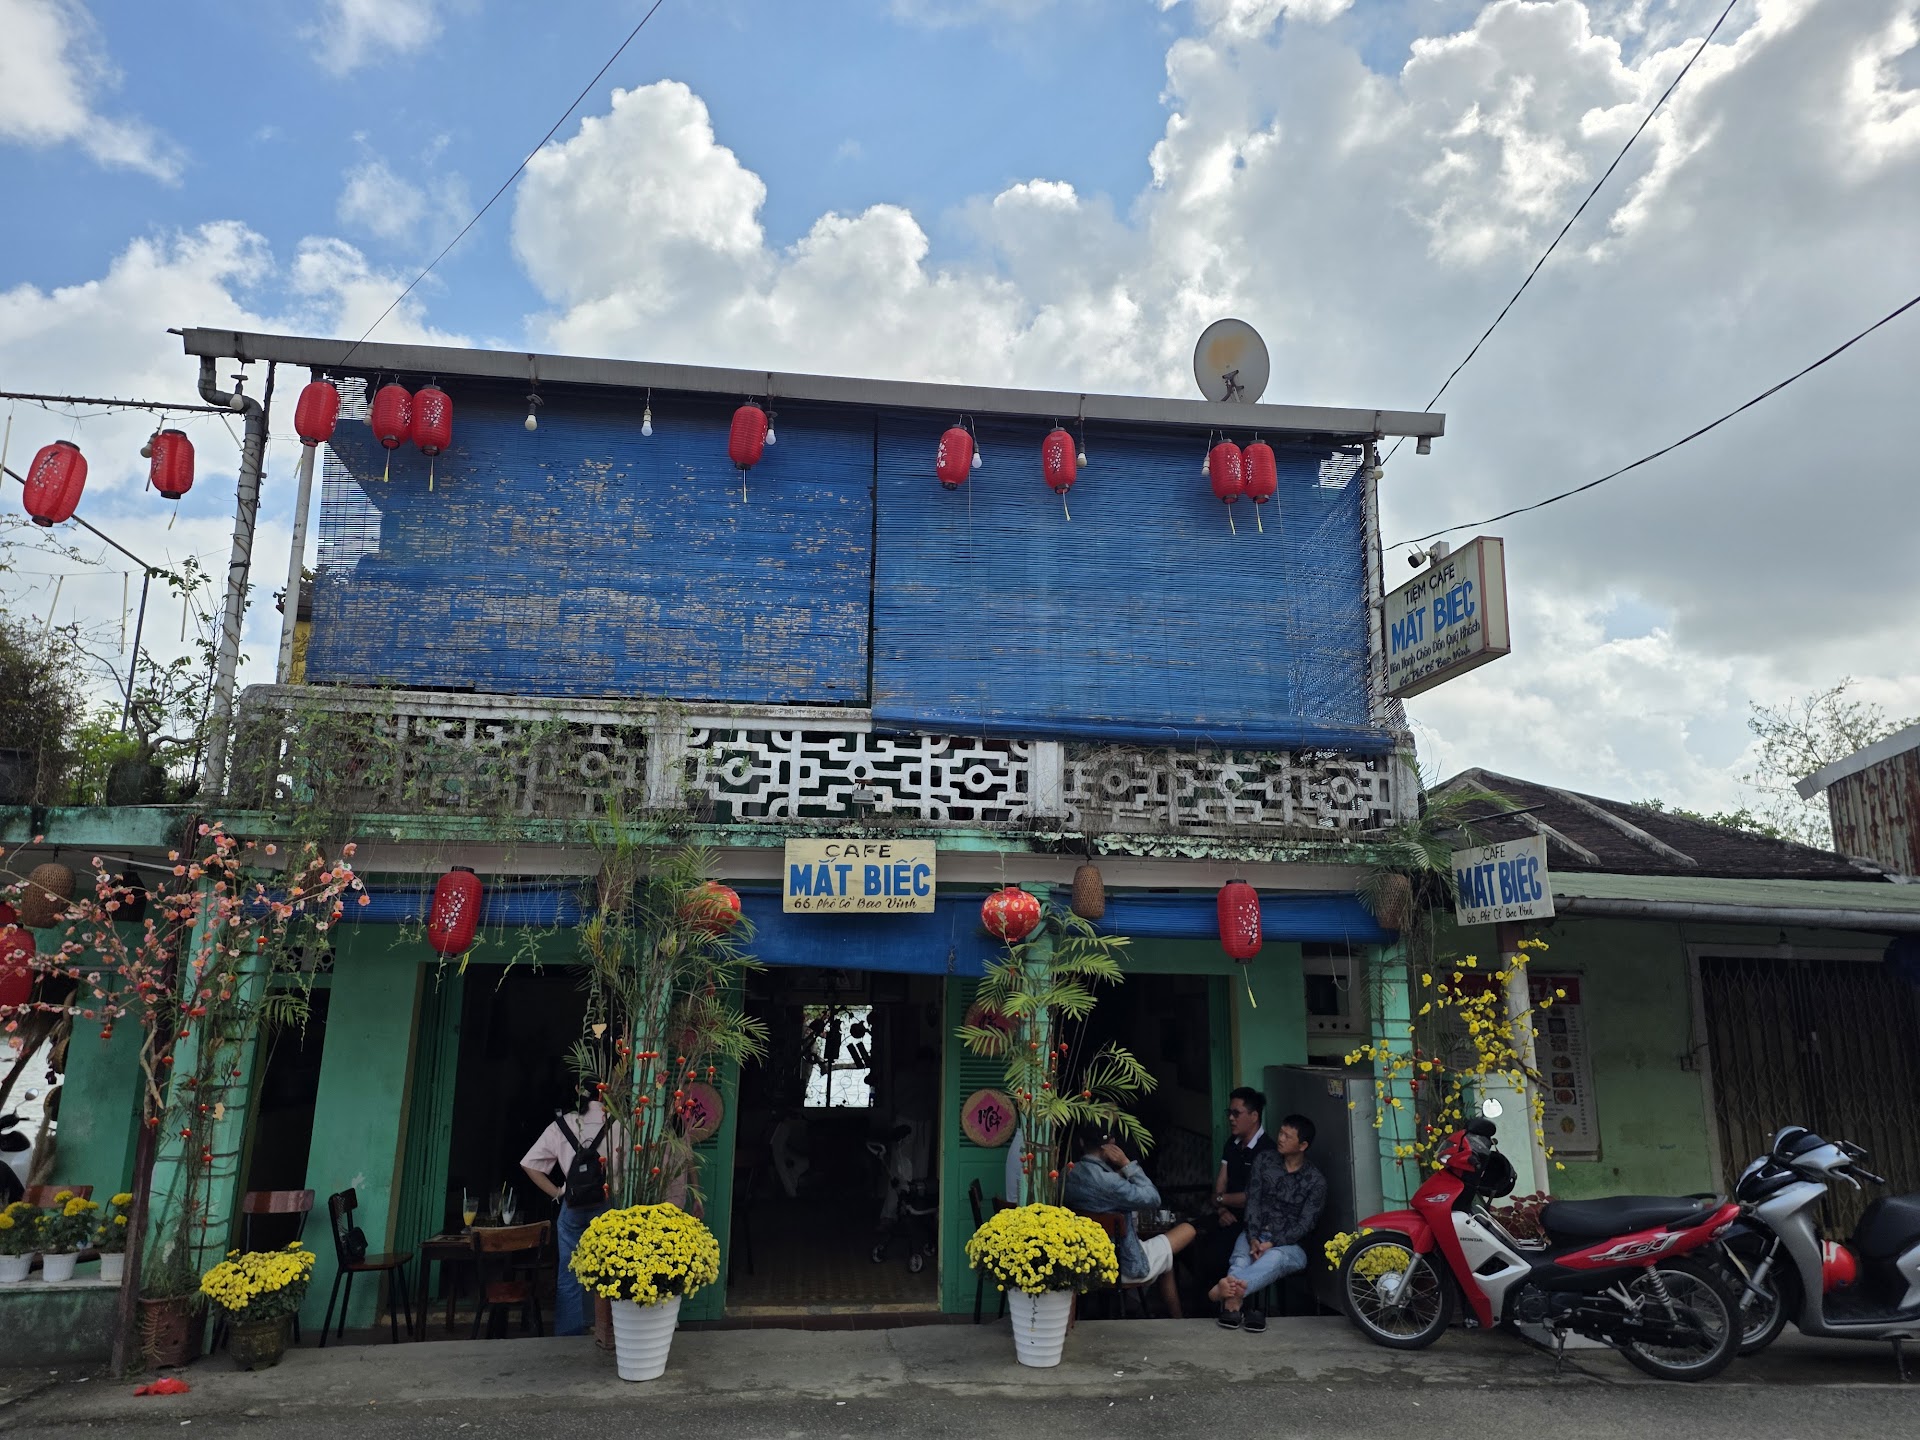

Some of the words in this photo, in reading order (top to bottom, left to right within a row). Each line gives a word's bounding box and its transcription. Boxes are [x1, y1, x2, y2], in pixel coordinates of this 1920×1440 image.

[1404, 581, 1426, 605] TIỆM
[1429, 562, 1455, 589] CAFE
[1392, 607, 1426, 655] MẮT
[1433, 577, 1475, 633] BIẾC
[1416, 646, 1431, 661] Chào
[1432, 638, 1446, 653] Đón
[1459, 618, 1480, 639] Khách
[825, 844, 891, 858] CAFE
[1483, 845, 1506, 861] CAFE
[789, 857, 853, 897] MẮT
[864, 857, 931, 897] BIẾC
[1457, 855, 1496, 909] MẮT
[1498, 848, 1542, 905] BIẾC
[857, 897, 882, 909] Bao
[886, 897, 918, 909] Vinh
